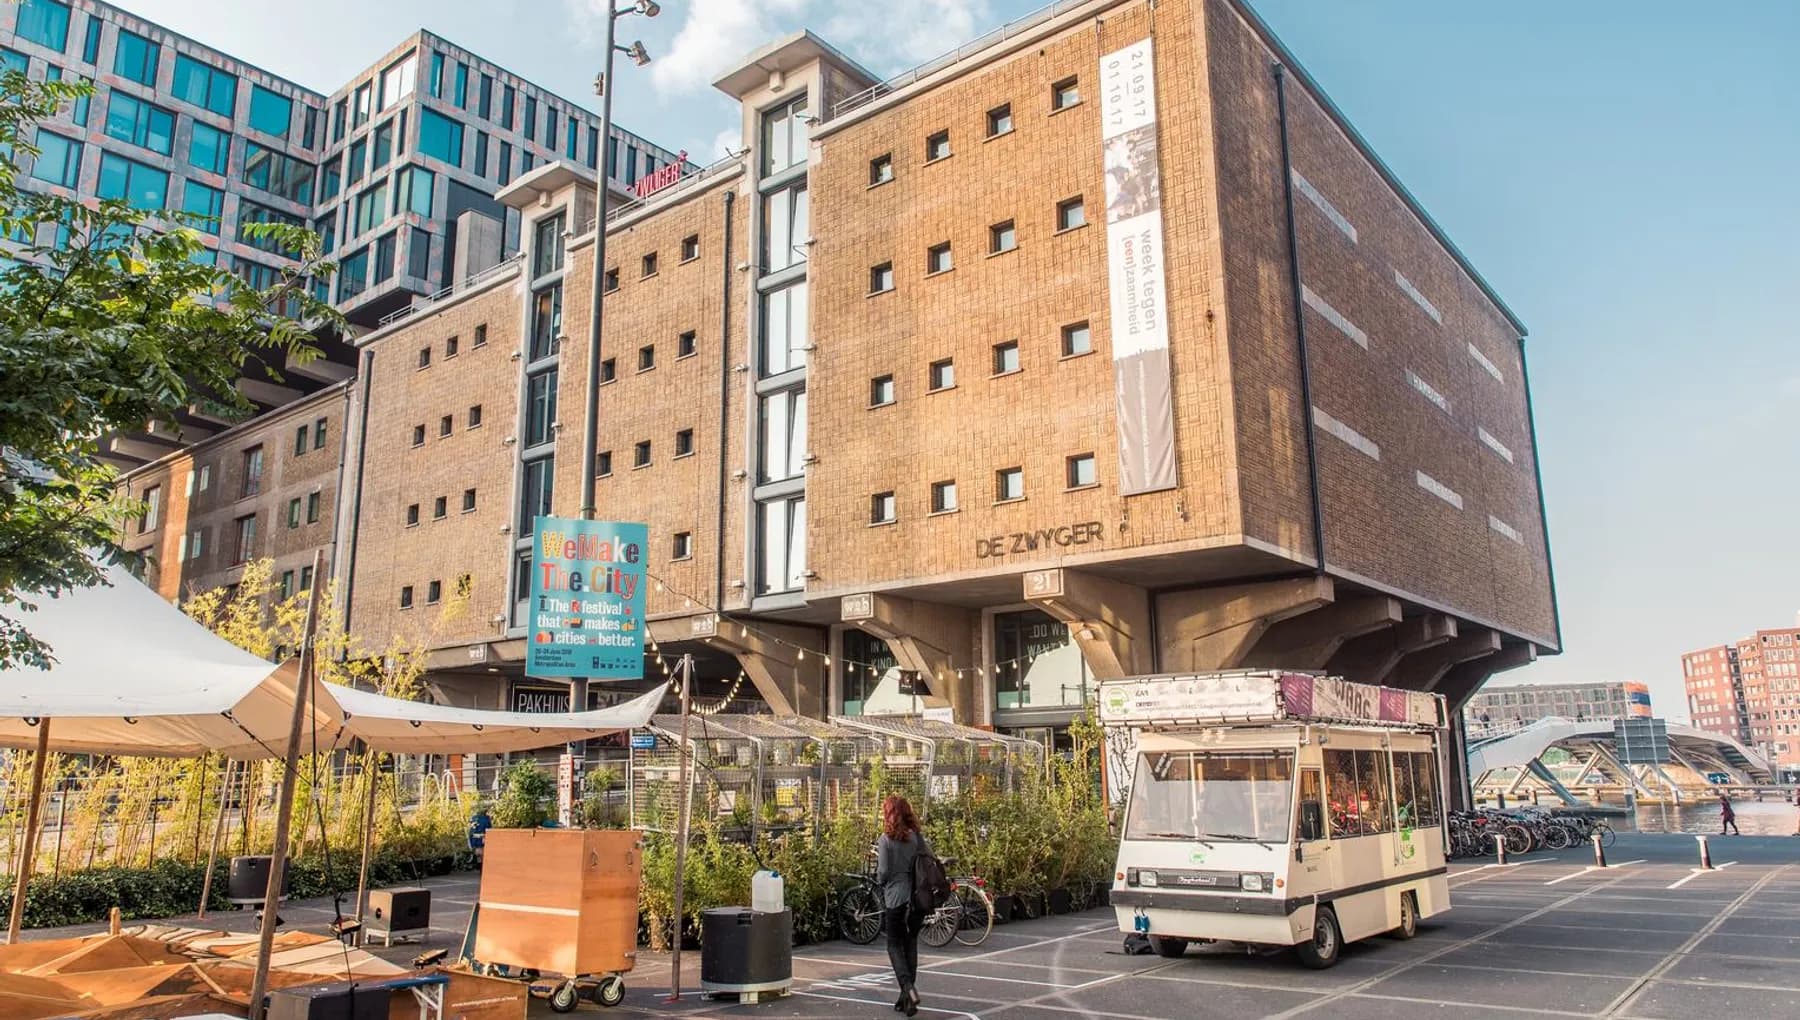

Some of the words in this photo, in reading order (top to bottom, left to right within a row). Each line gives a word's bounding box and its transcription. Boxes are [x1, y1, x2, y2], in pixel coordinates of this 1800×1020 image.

[1141, 229, 1155, 276] week
[1141, 279, 1156, 331] tegen
[541, 530, 640, 564] WeMake
[976, 535, 1006, 559] DE
[1009, 521, 1104, 554] ZWYGER
[537, 616, 560, 628] that
[584, 618, 620, 631] makes
[550, 599, 569, 613] The
[582, 600, 622, 615] festival
[555, 632, 586, 645] cities
[598, 632, 636, 647] better.
